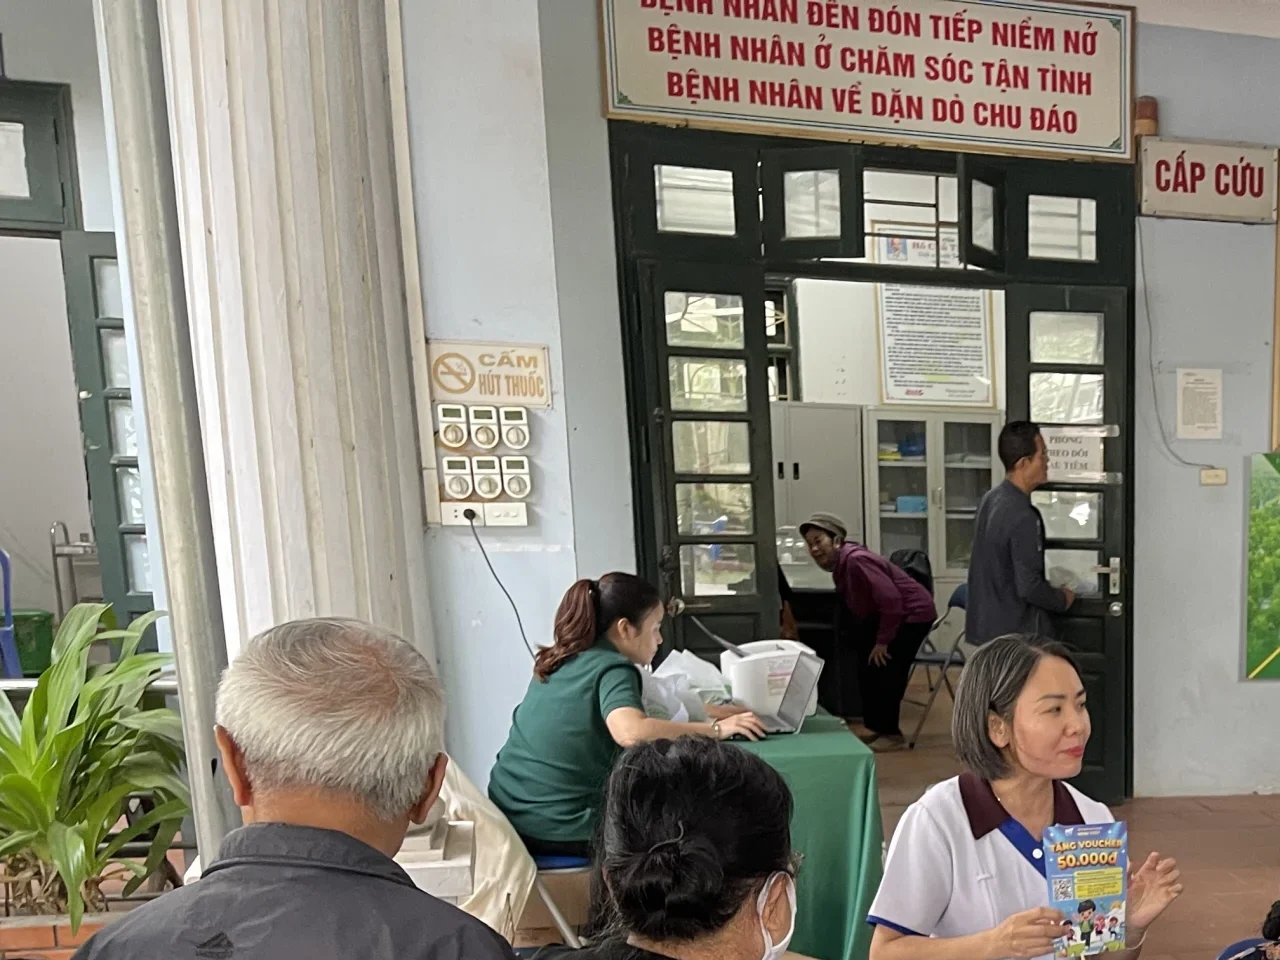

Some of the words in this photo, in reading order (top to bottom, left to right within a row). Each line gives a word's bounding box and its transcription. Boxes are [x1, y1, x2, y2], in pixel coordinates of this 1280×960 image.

[868, 5, 921, 38] ĐÓN
[929, 8, 983, 43] TIẾP
[1063, 21, 1098, 56] NỞ
[647, 23, 721, 60] BỆNH
[730, 34, 806, 67] NHÂN
[815, 33, 832, 70] Ở
[840, 44, 916, 78] CHĂM
[924, 52, 974, 84] SÓC
[981, 58, 1029, 93] TẬN
[1037, 63, 1092, 96] TÌNH
[667, 67, 740, 104] BỆNH
[748, 78, 823, 111] NHÂN
[831, 81, 862, 114] VỀ
[871, 88, 923, 124] DẶN
[932, 93, 964, 124] DÒ
[973, 101, 1022, 130] CHU
[1029, 103, 1078, 135] ĐÁO
[1155, 150, 1206, 193] CẤP
[1214, 156, 1264, 198] CỨU
[478, 349, 538, 368] CẤM
[478, 369, 502, 396] HÚT
[504, 371, 545, 398] THUỐC
[1077, 839, 1122, 849] VOUCHER
